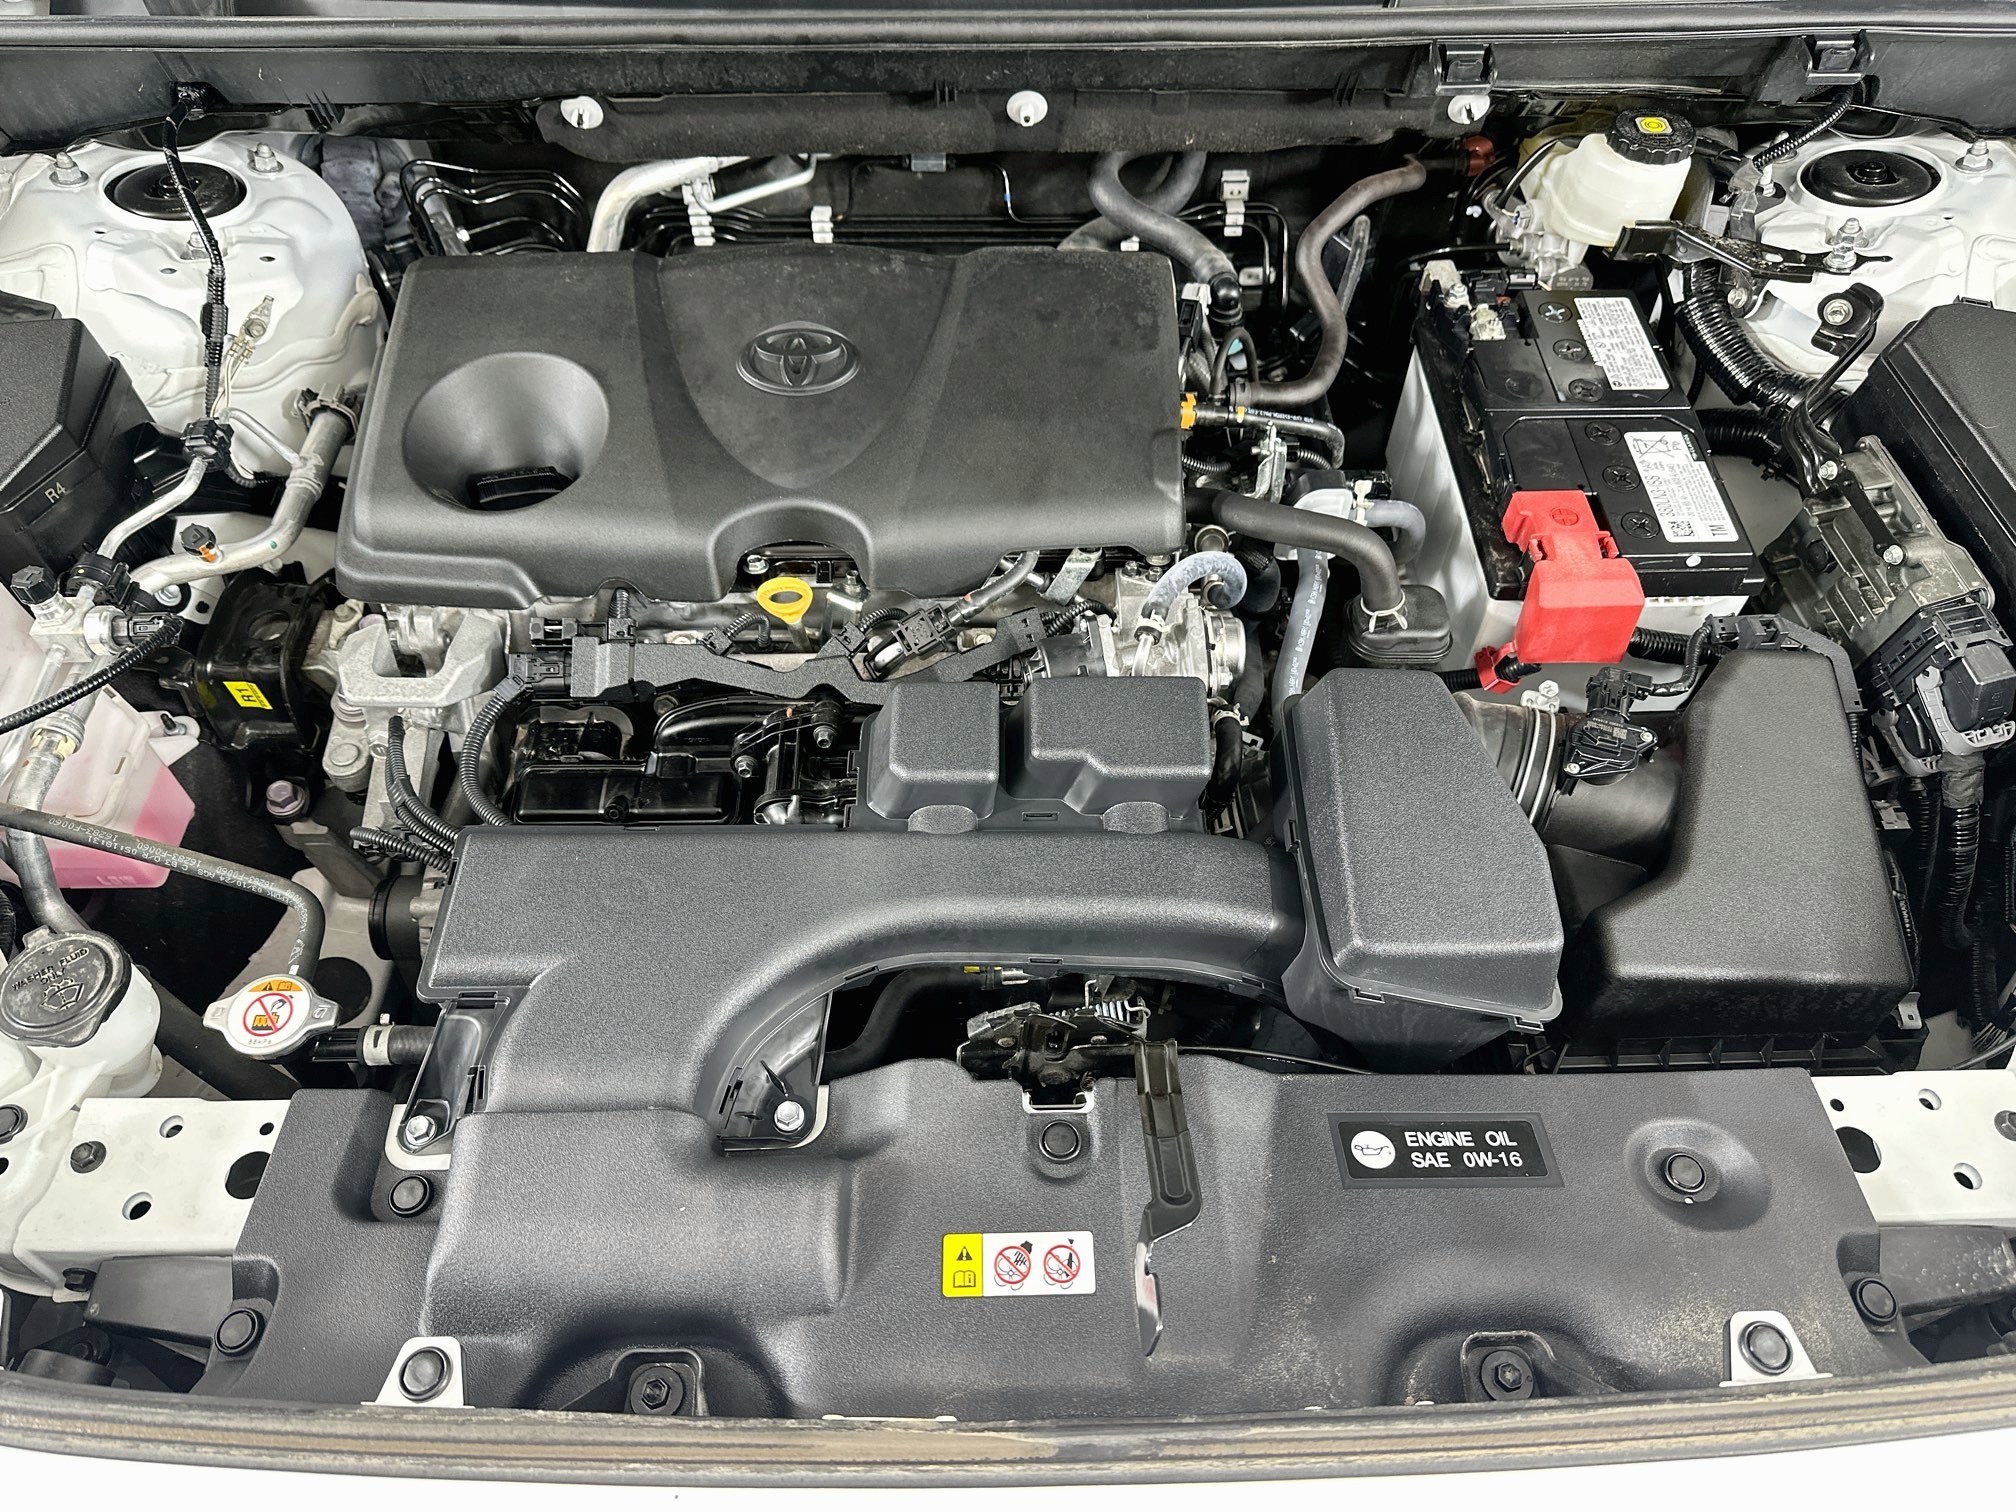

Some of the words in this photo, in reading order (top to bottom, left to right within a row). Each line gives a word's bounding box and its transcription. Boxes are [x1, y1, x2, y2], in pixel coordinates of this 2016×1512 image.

[44, 481, 66, 503] R4
[1708, 524, 1729, 537] TM
[236, 688, 257, 702] R1
[48, 817, 118, 841] 16283-F0060
[87, 834, 138, 855] 05:18:31
[137, 842, 203, 868] 16283-F0060
[215, 866, 275, 889] 16283-F0060
[219, 874, 263, 893] 03/10/24
[11, 965, 54, 991] WASHER
[59, 948, 89, 967] FLUID
[40, 967, 66, 985] ONLY
[1404, 1131, 1475, 1147] ENGINE
[1484, 1130, 1518, 1147] OIL
[1411, 1151, 1451, 1168] SAE
[1463, 1151, 1523, 1168] 0W-16
